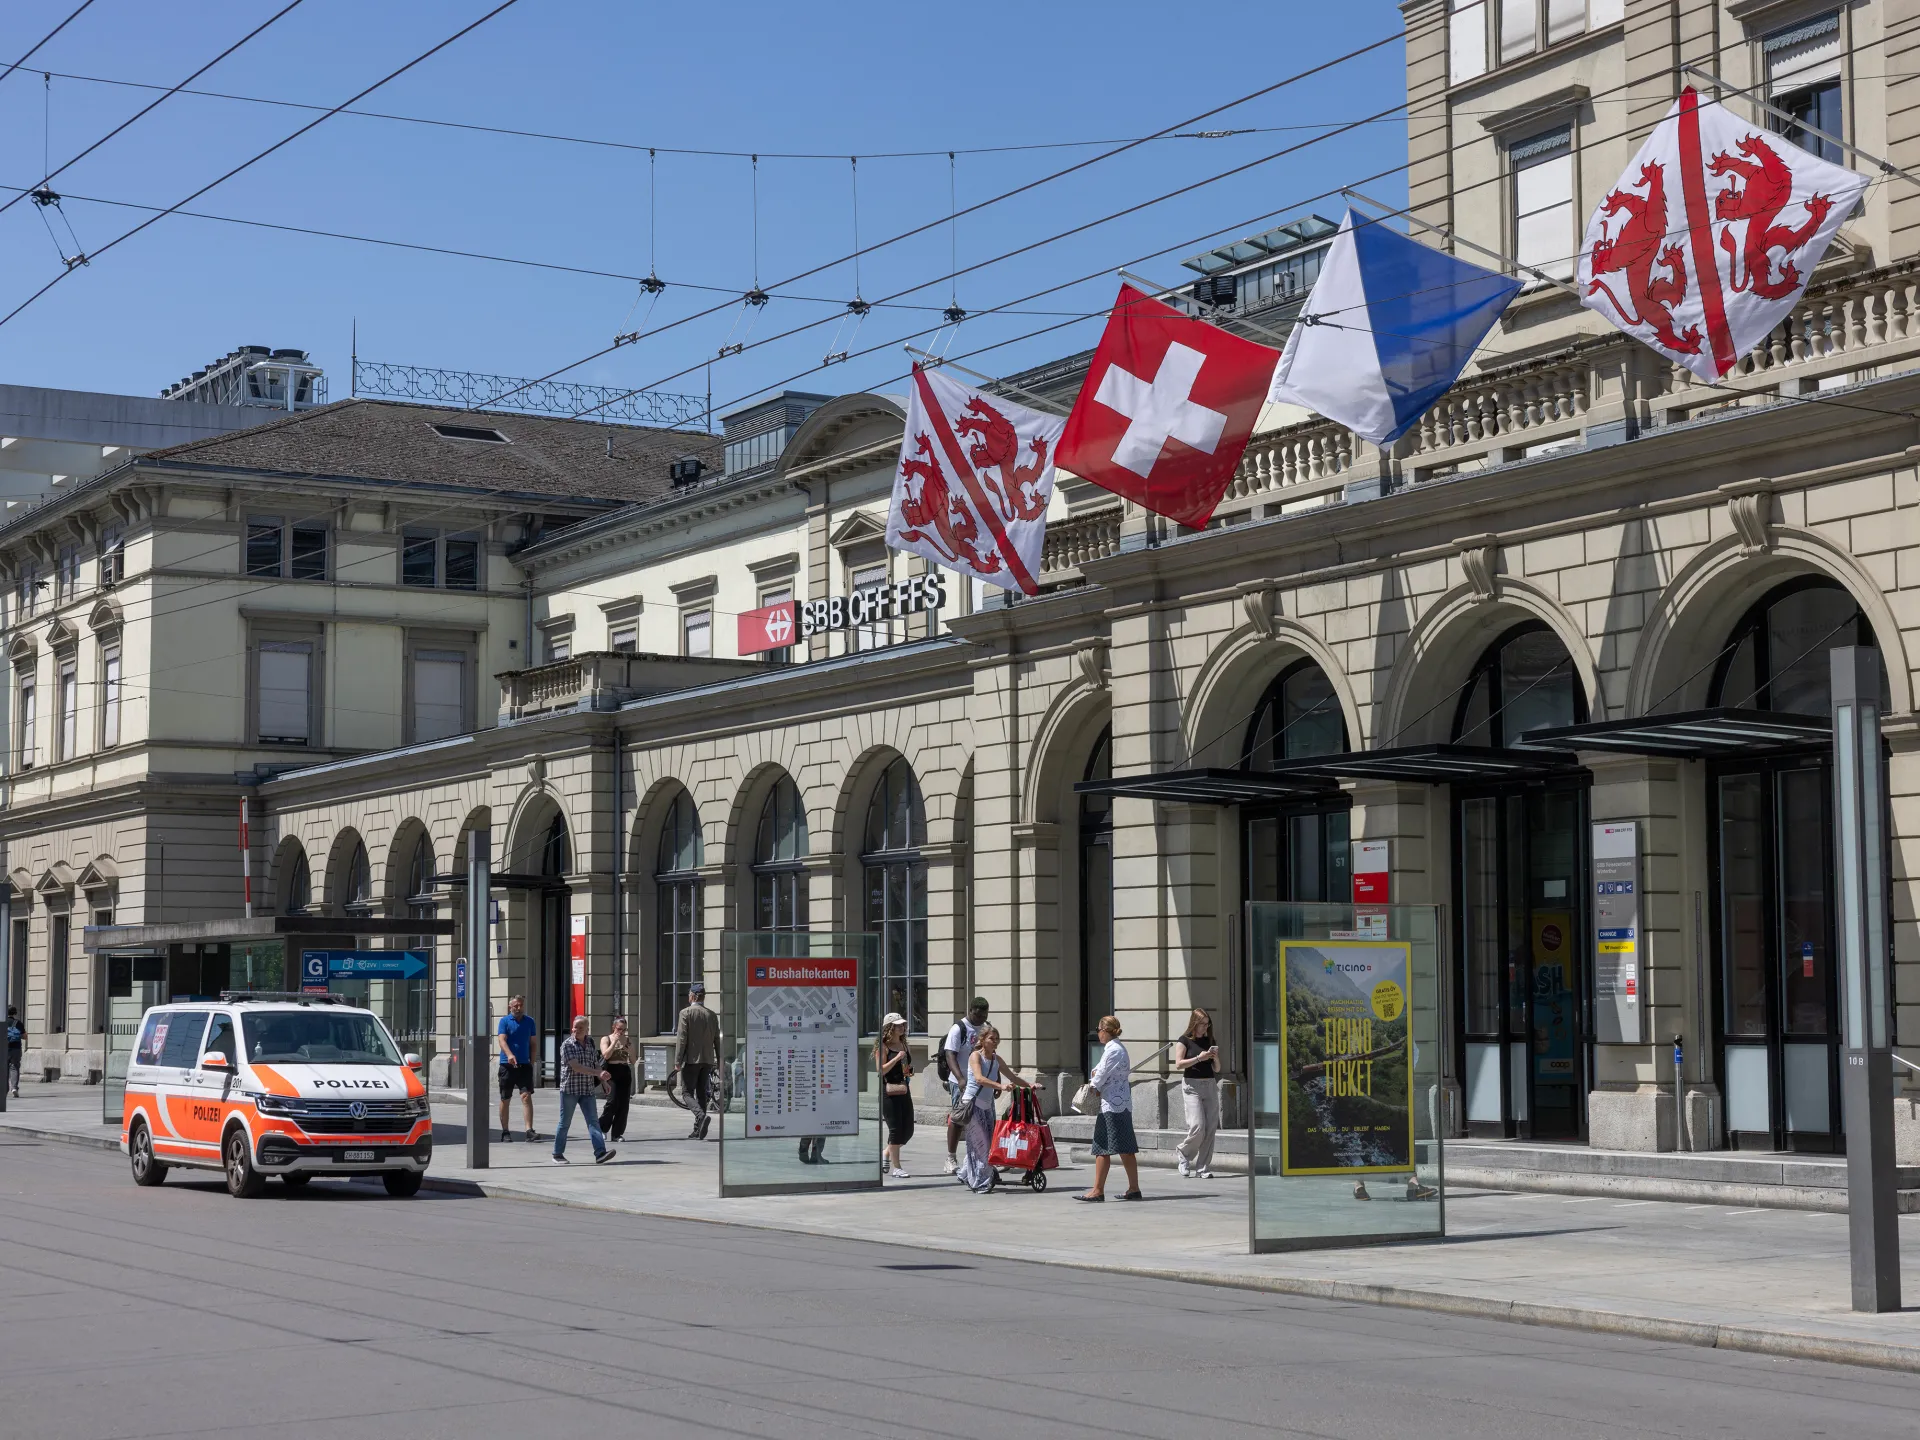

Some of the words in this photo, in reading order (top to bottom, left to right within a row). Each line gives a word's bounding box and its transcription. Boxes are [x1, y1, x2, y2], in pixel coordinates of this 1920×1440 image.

[802, 597, 845, 636] SBB
[848, 586, 890, 625] CFF
[897, 573, 940, 614] FFS
[308, 958, 323, 975] G
[768, 966, 850, 980] Bushaltekanten
[1323, 1018, 1372, 1054] TICINO
[1550, 1061, 1570, 1069] coop
[232, 1078, 242, 1088] 201
[312, 1079, 390, 1089] POLIZEI
[1323, 1060, 1374, 1097] TICKET
[193, 1105, 221, 1122] POLIZEI
